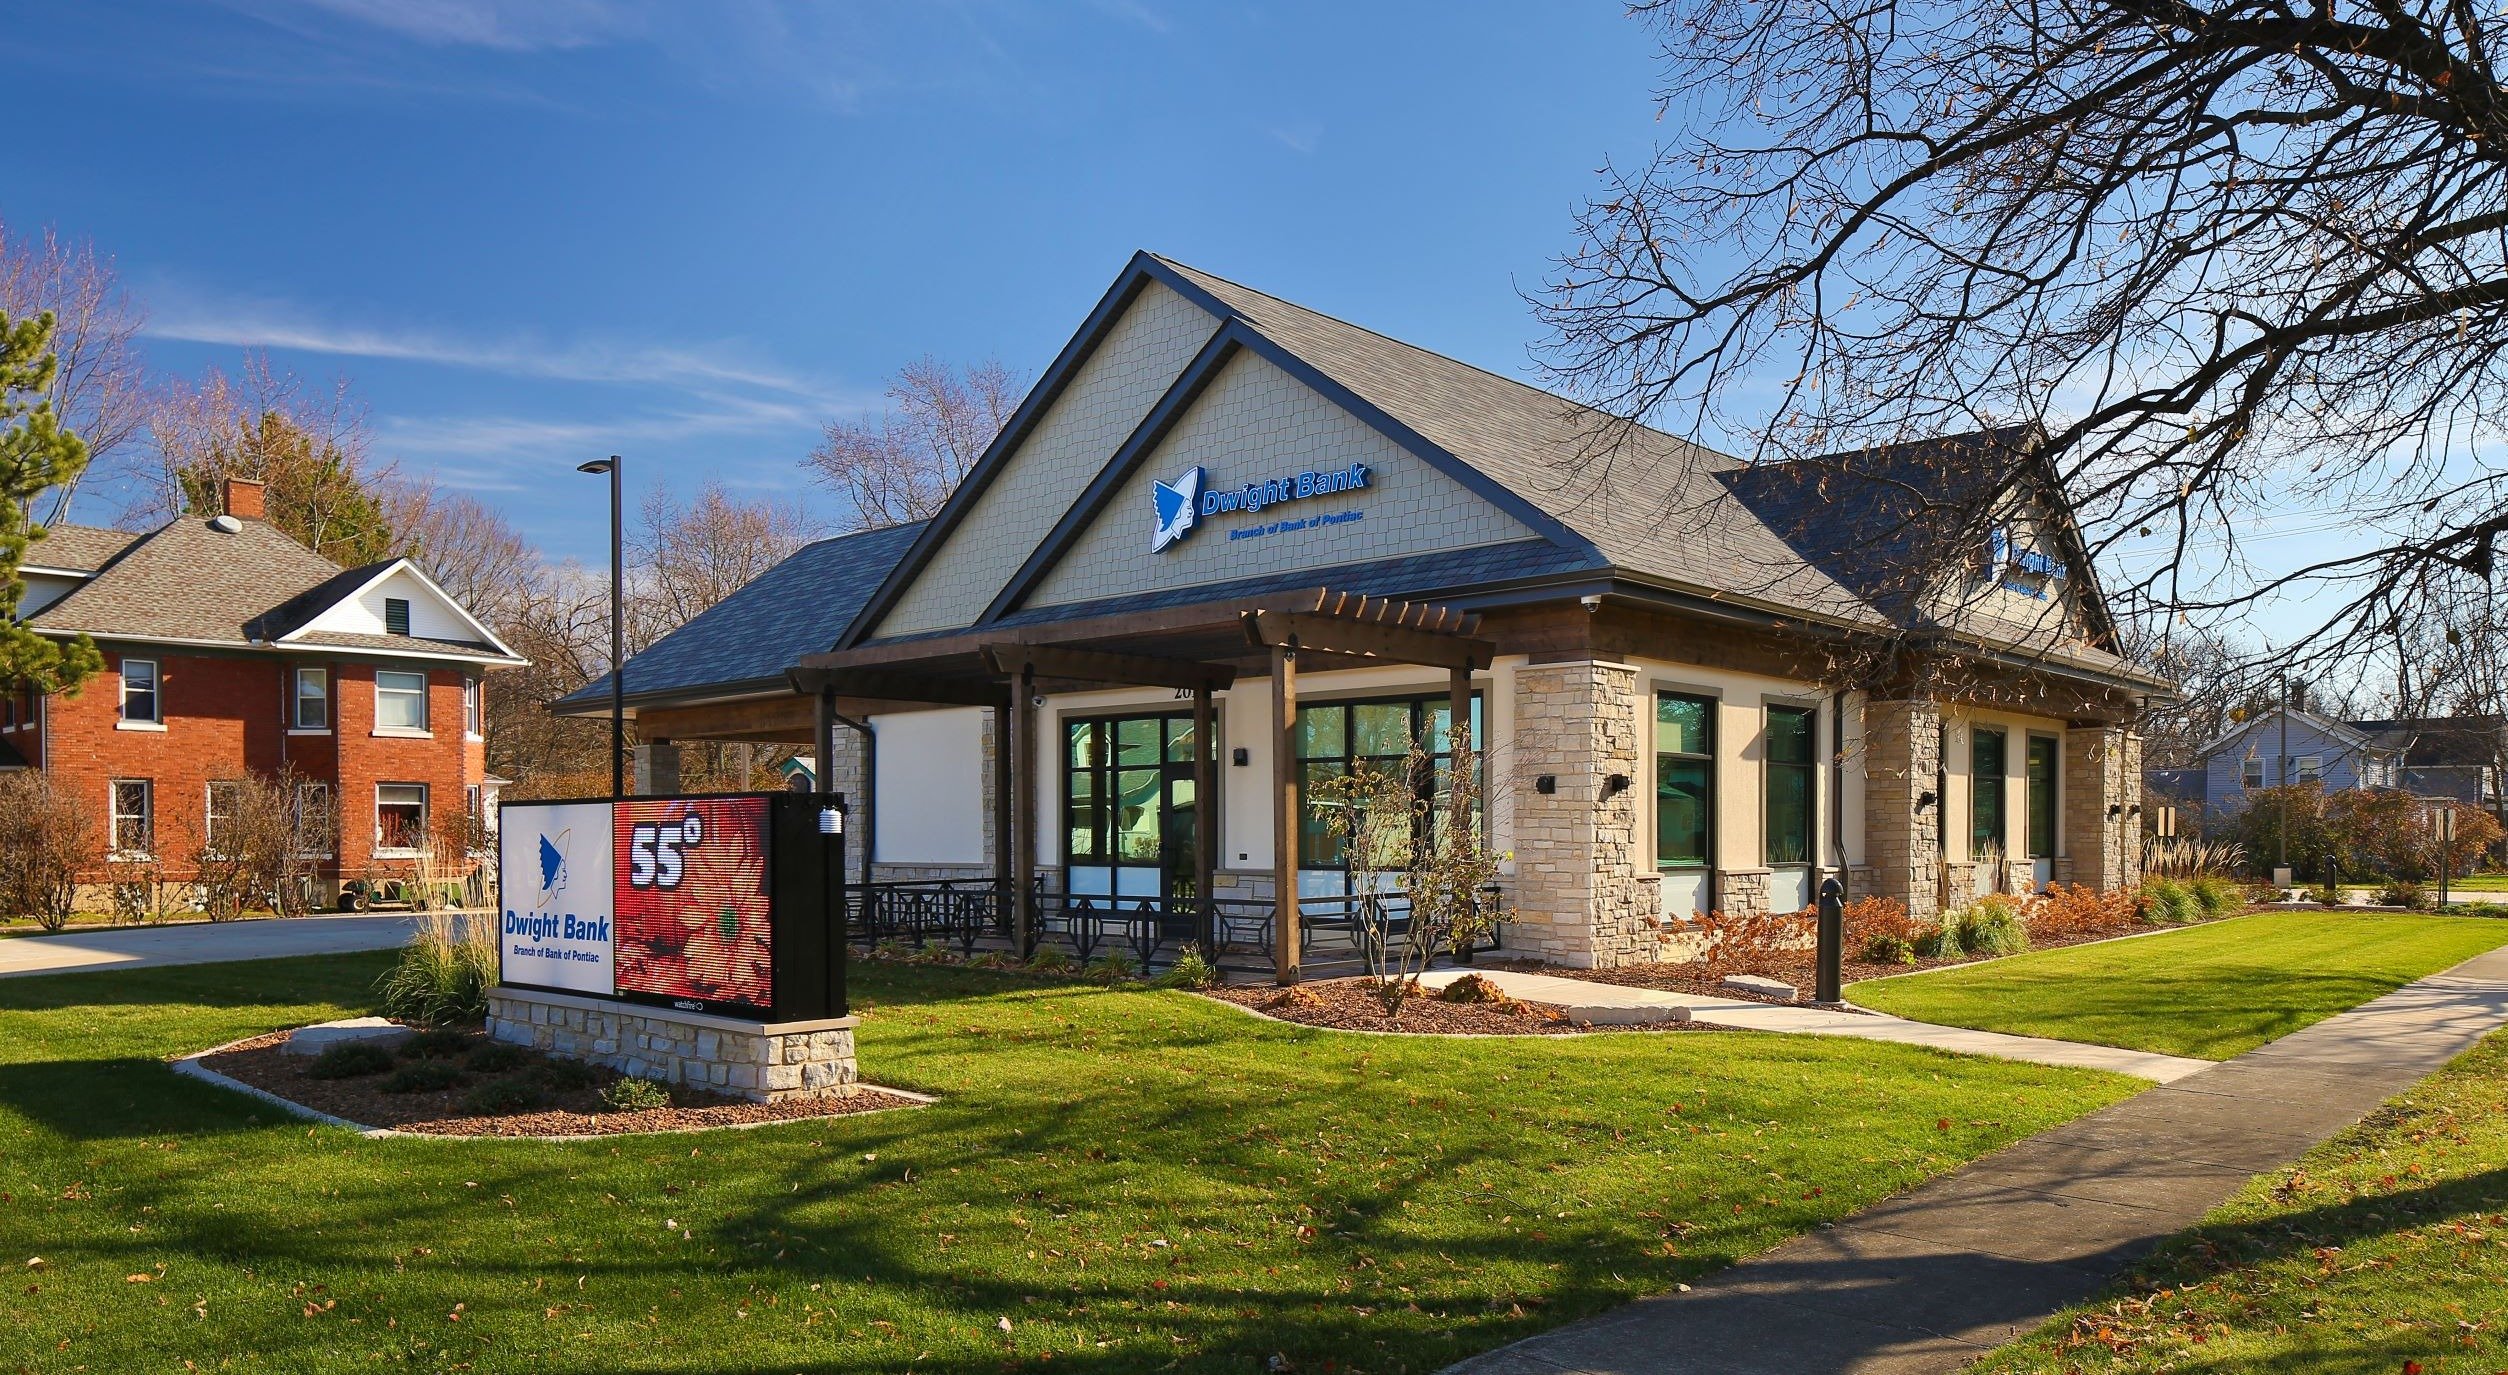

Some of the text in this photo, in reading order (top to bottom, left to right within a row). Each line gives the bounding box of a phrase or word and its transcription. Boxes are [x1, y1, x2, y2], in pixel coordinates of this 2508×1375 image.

[1202, 462, 1366, 516] Dwight Bank
[1230, 511, 1364, 541] Branch of Bank of Pontiac
[505, 909, 610, 942] Dwight Bank
[513, 944, 600, 963] Branch of Bank of Pontiac
